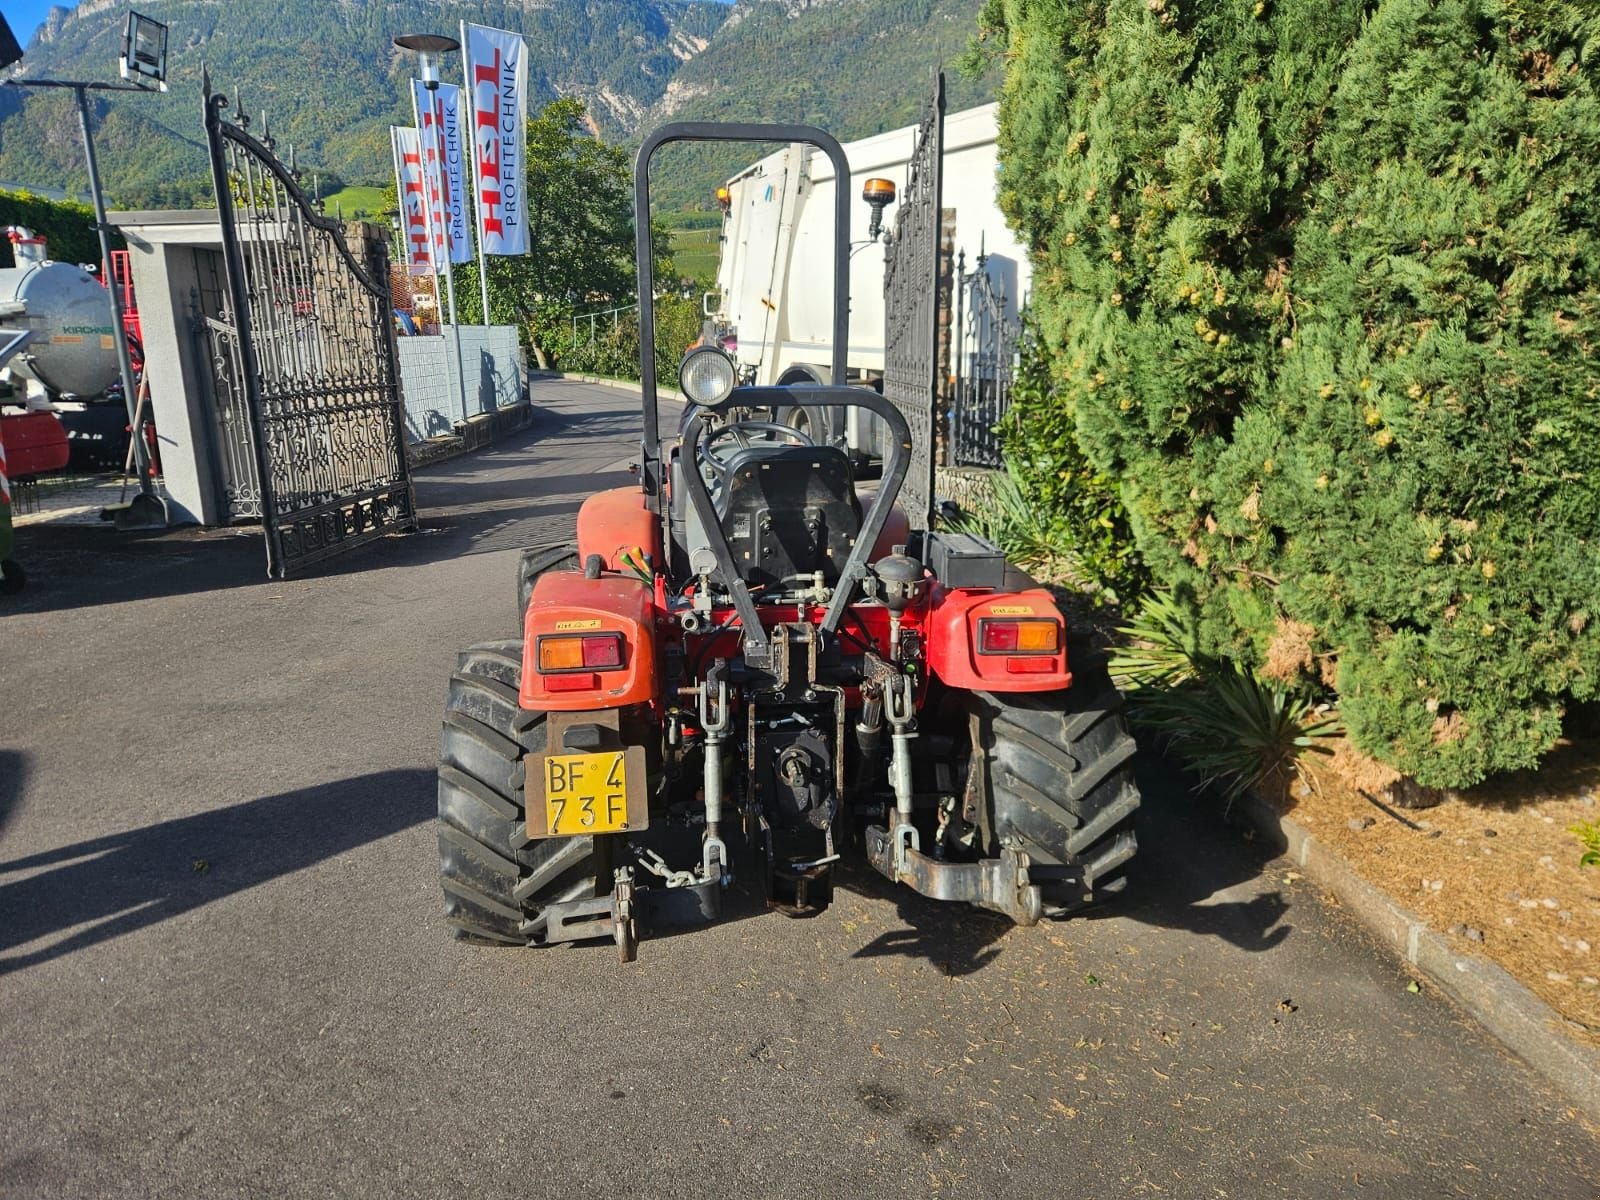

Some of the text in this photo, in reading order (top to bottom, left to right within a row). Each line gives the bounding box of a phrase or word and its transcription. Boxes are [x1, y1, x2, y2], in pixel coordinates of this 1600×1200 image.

[402, 141, 431, 265] HELL
[475, 48, 505, 240] HELL
[503, 60, 517, 226] PROFITECHNIK
[62, 326, 114, 335] KIRCHNE
[550, 755, 622, 793] BF 4
